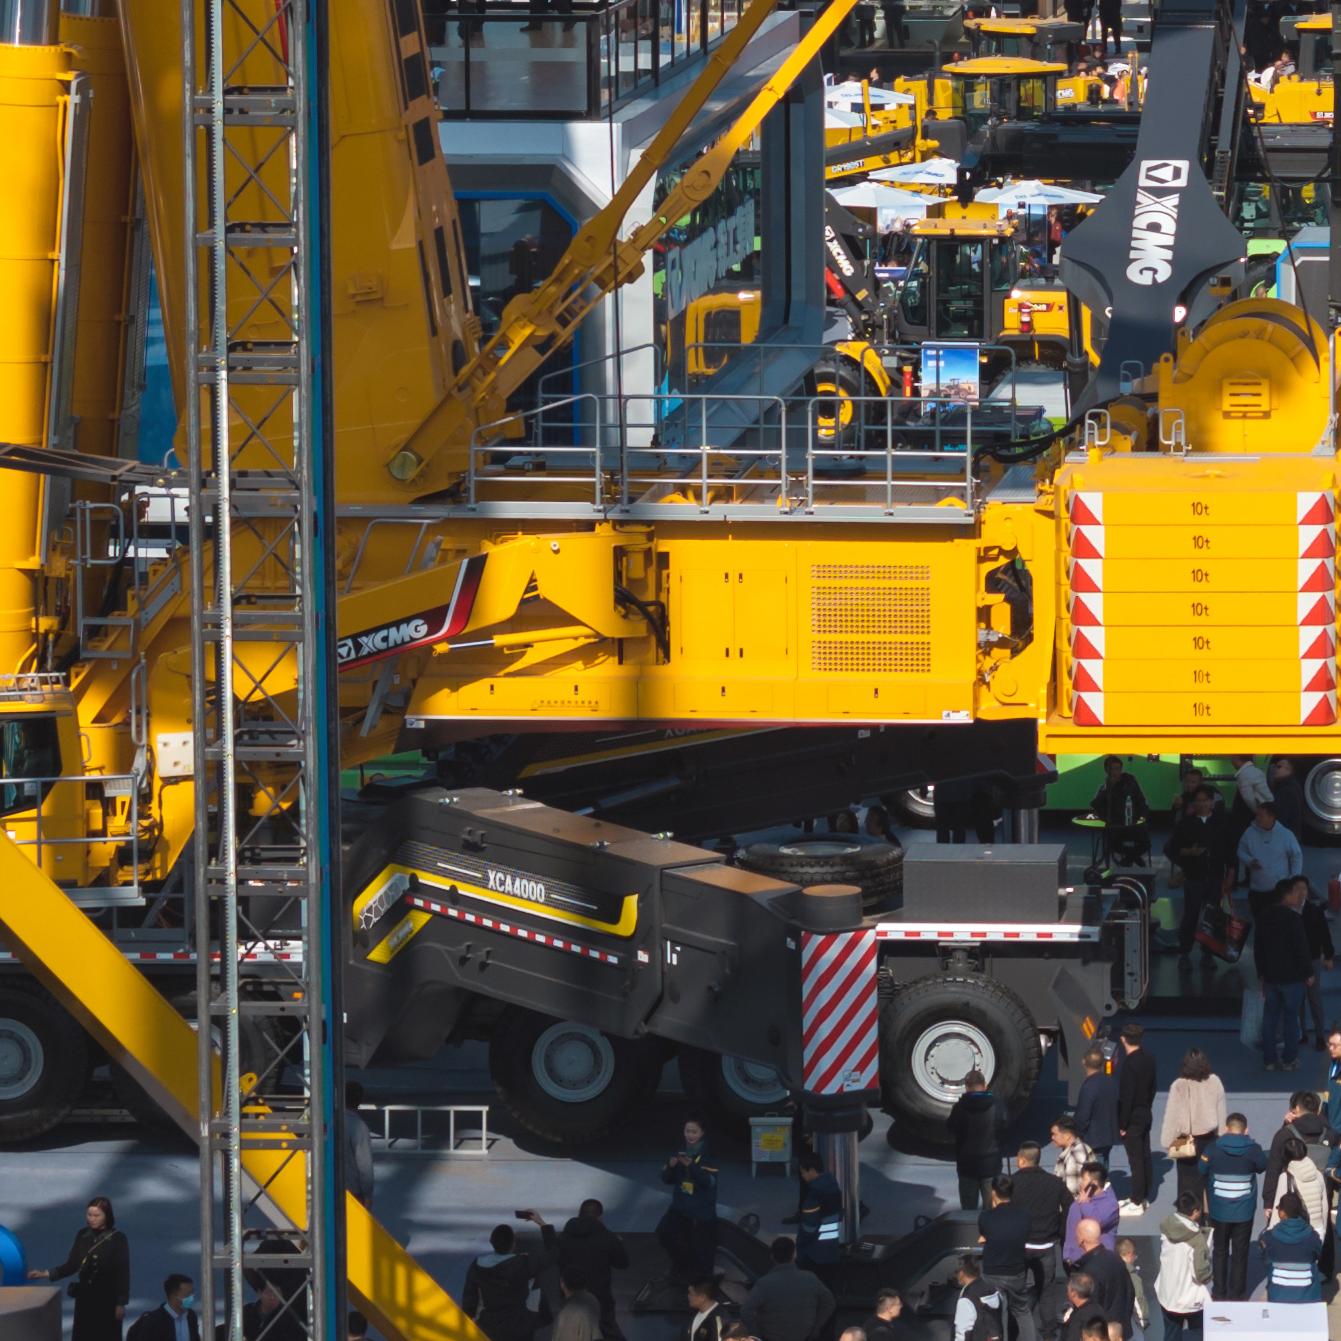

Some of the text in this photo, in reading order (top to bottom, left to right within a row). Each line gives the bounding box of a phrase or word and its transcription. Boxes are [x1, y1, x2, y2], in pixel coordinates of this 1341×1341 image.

[1126, 189, 1181, 286] XCMG
[828, 235, 855, 277] XCMG
[1191, 501, 1210, 516] 10t
[1192, 535, 1211, 550] 10t
[1191, 568, 1210, 583] 10t
[1191, 602, 1210, 617] 10t
[357, 618, 429, 658] XCMG
[1193, 636, 1212, 651] 10t
[1192, 669, 1211, 684] 10t
[1192, 702, 1211, 717] 10t
[487, 867, 546, 904] XCA4000
